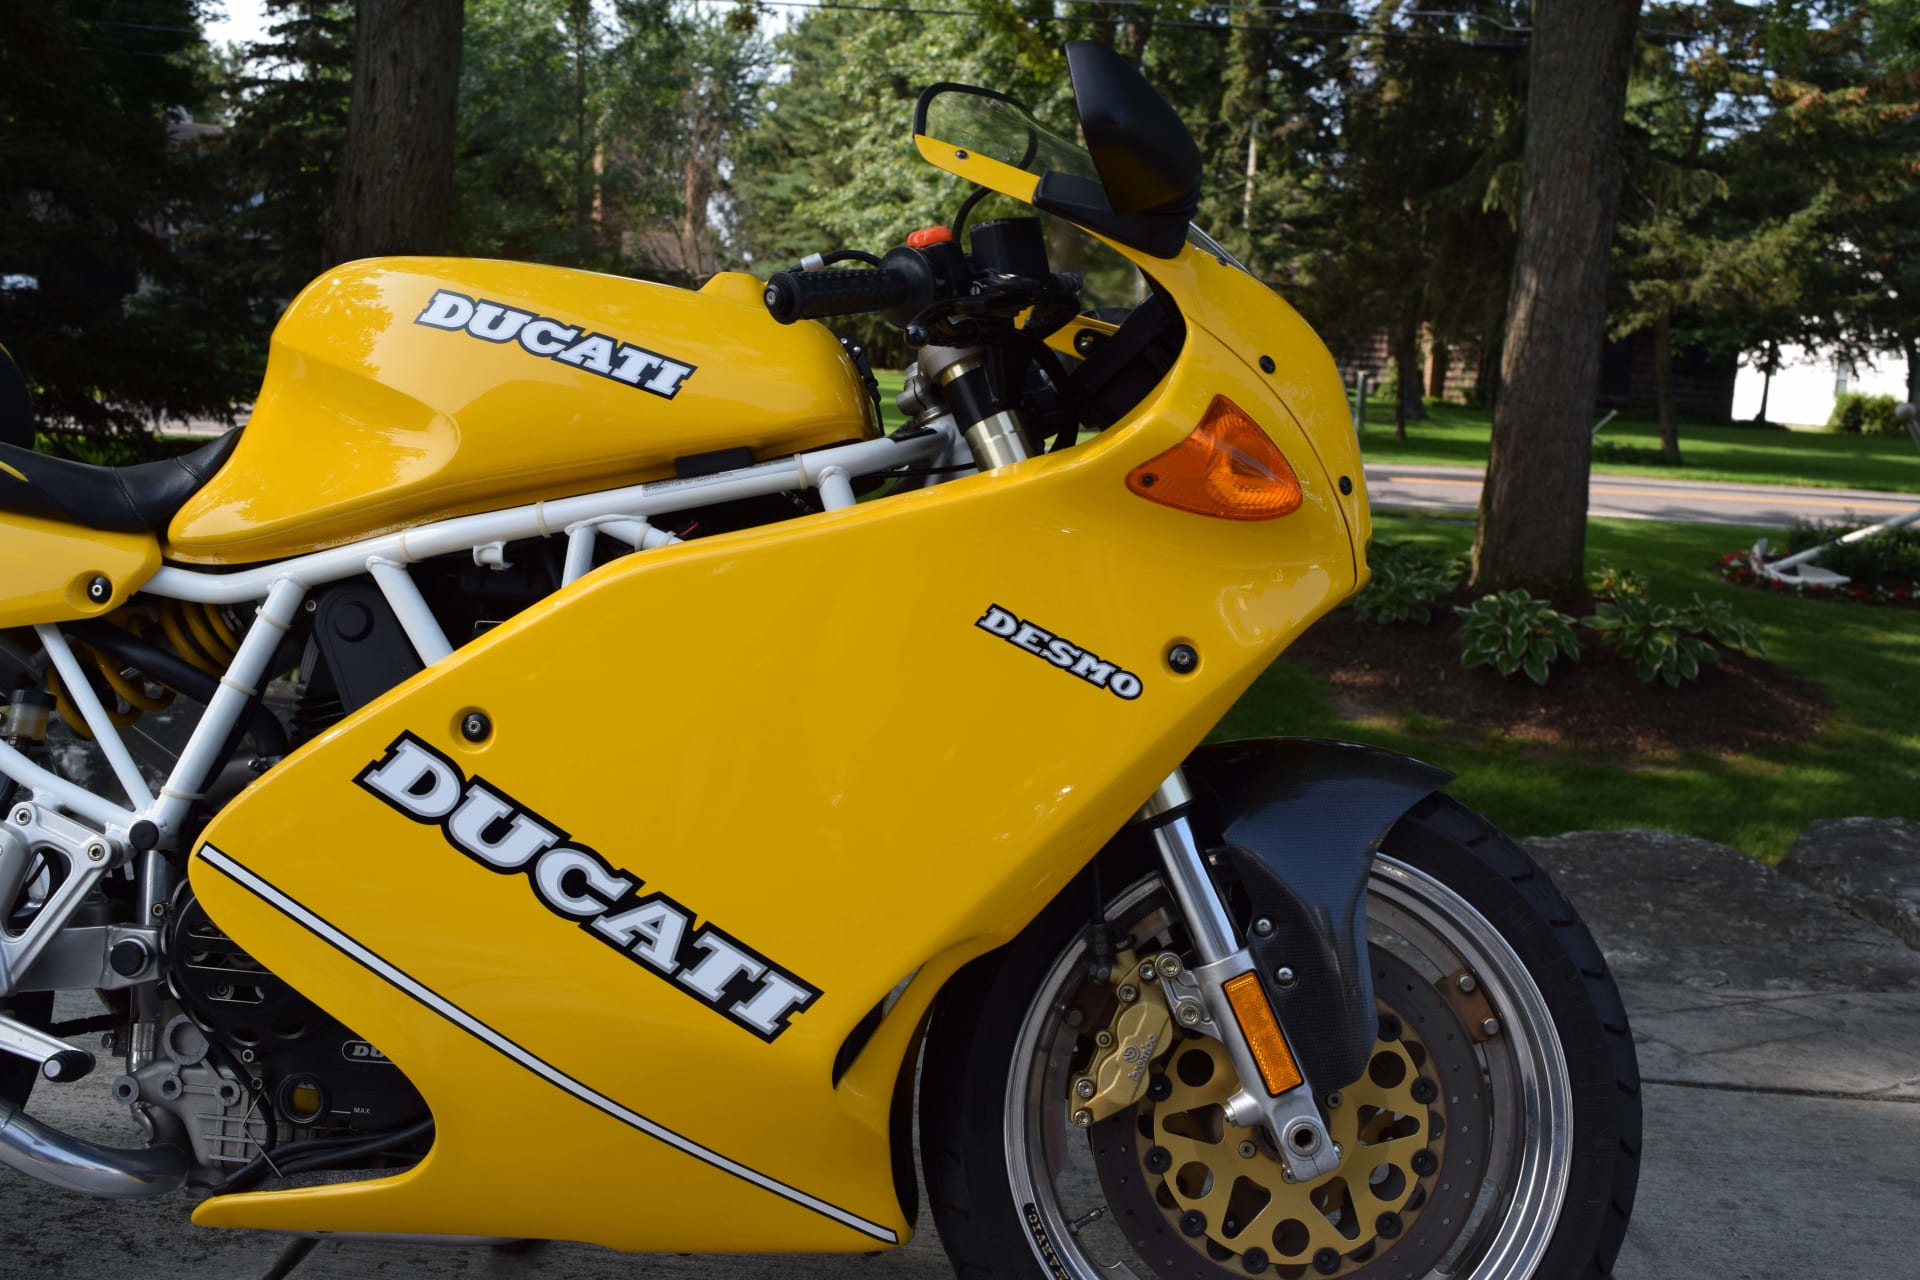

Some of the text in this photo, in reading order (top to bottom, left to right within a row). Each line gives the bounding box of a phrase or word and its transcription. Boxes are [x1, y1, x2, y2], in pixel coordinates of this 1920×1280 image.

[416, 290, 694, 398] DUCATI
[976, 605, 1142, 699] DESMO
[359, 735, 817, 1039] DUCATI
[353, 1106, 370, 1114] MAX
